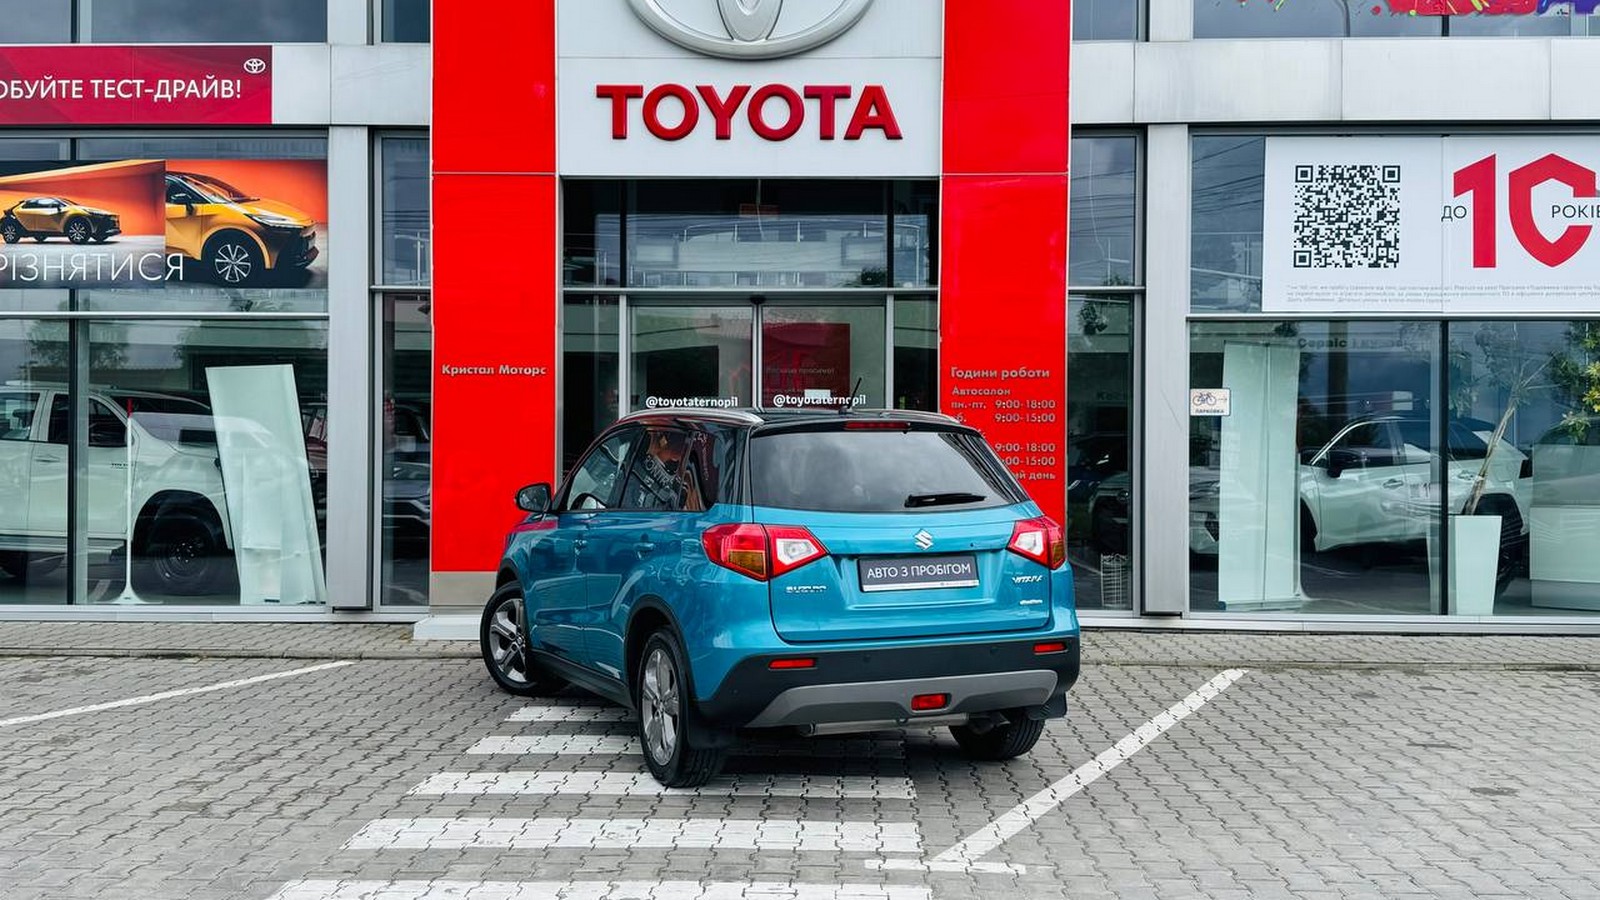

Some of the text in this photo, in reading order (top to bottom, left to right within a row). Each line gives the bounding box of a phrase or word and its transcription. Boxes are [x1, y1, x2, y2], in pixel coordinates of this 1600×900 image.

[91, 75, 241, 102] ТЕСТ-ДРАЙВ!
[596, 84, 903, 141] TOYOTA
[1441, 205, 1467, 222] ДО
[442, 364, 547, 376] Кристал Моторс
[951, 367, 1050, 380] Години роботи
[952, 386, 1011, 395] Автосалон
[646, 396, 738, 409] @toyotaternopil
[1002, 456, 1056, 466] :00-15:00
[867, 563, 971, 579] АВТО З ПРОБІГОМ
